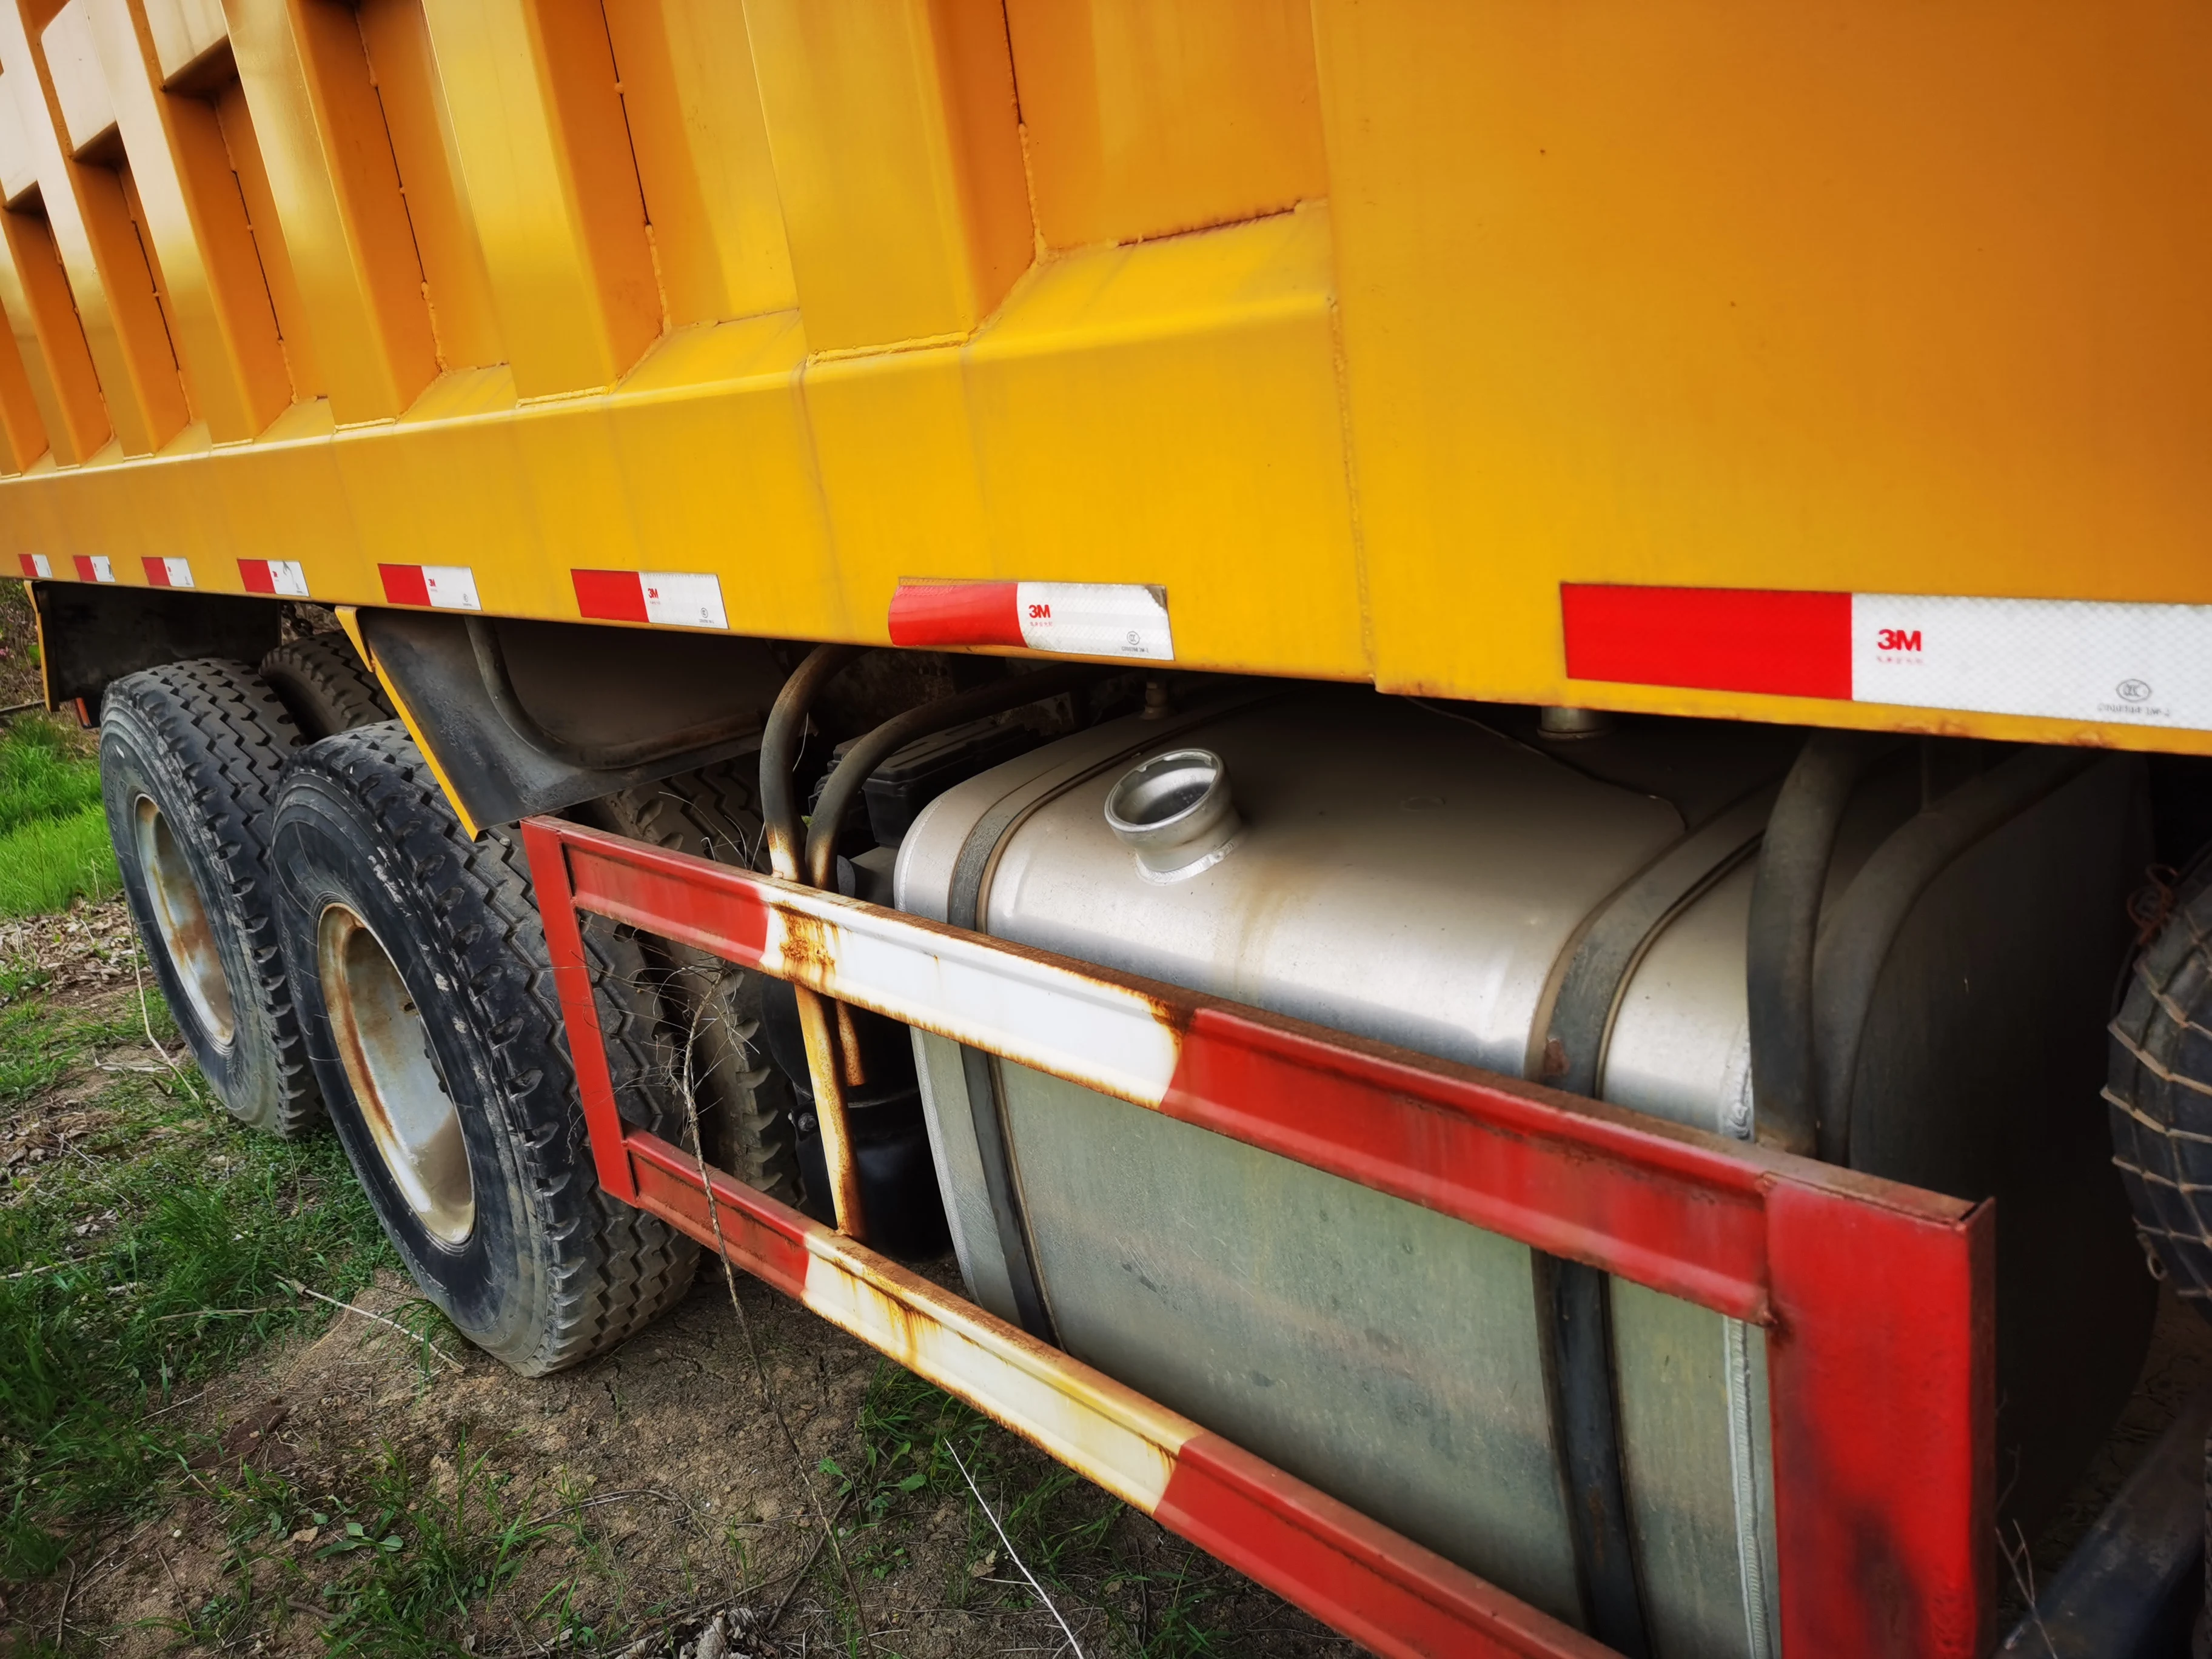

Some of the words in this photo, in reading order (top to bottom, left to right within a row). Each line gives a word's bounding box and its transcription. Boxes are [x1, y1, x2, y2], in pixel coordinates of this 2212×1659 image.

[648, 588, 659, 598] 3M
[1028, 604, 1051, 618] 3M
[1877, 629, 1922, 652] 3M
